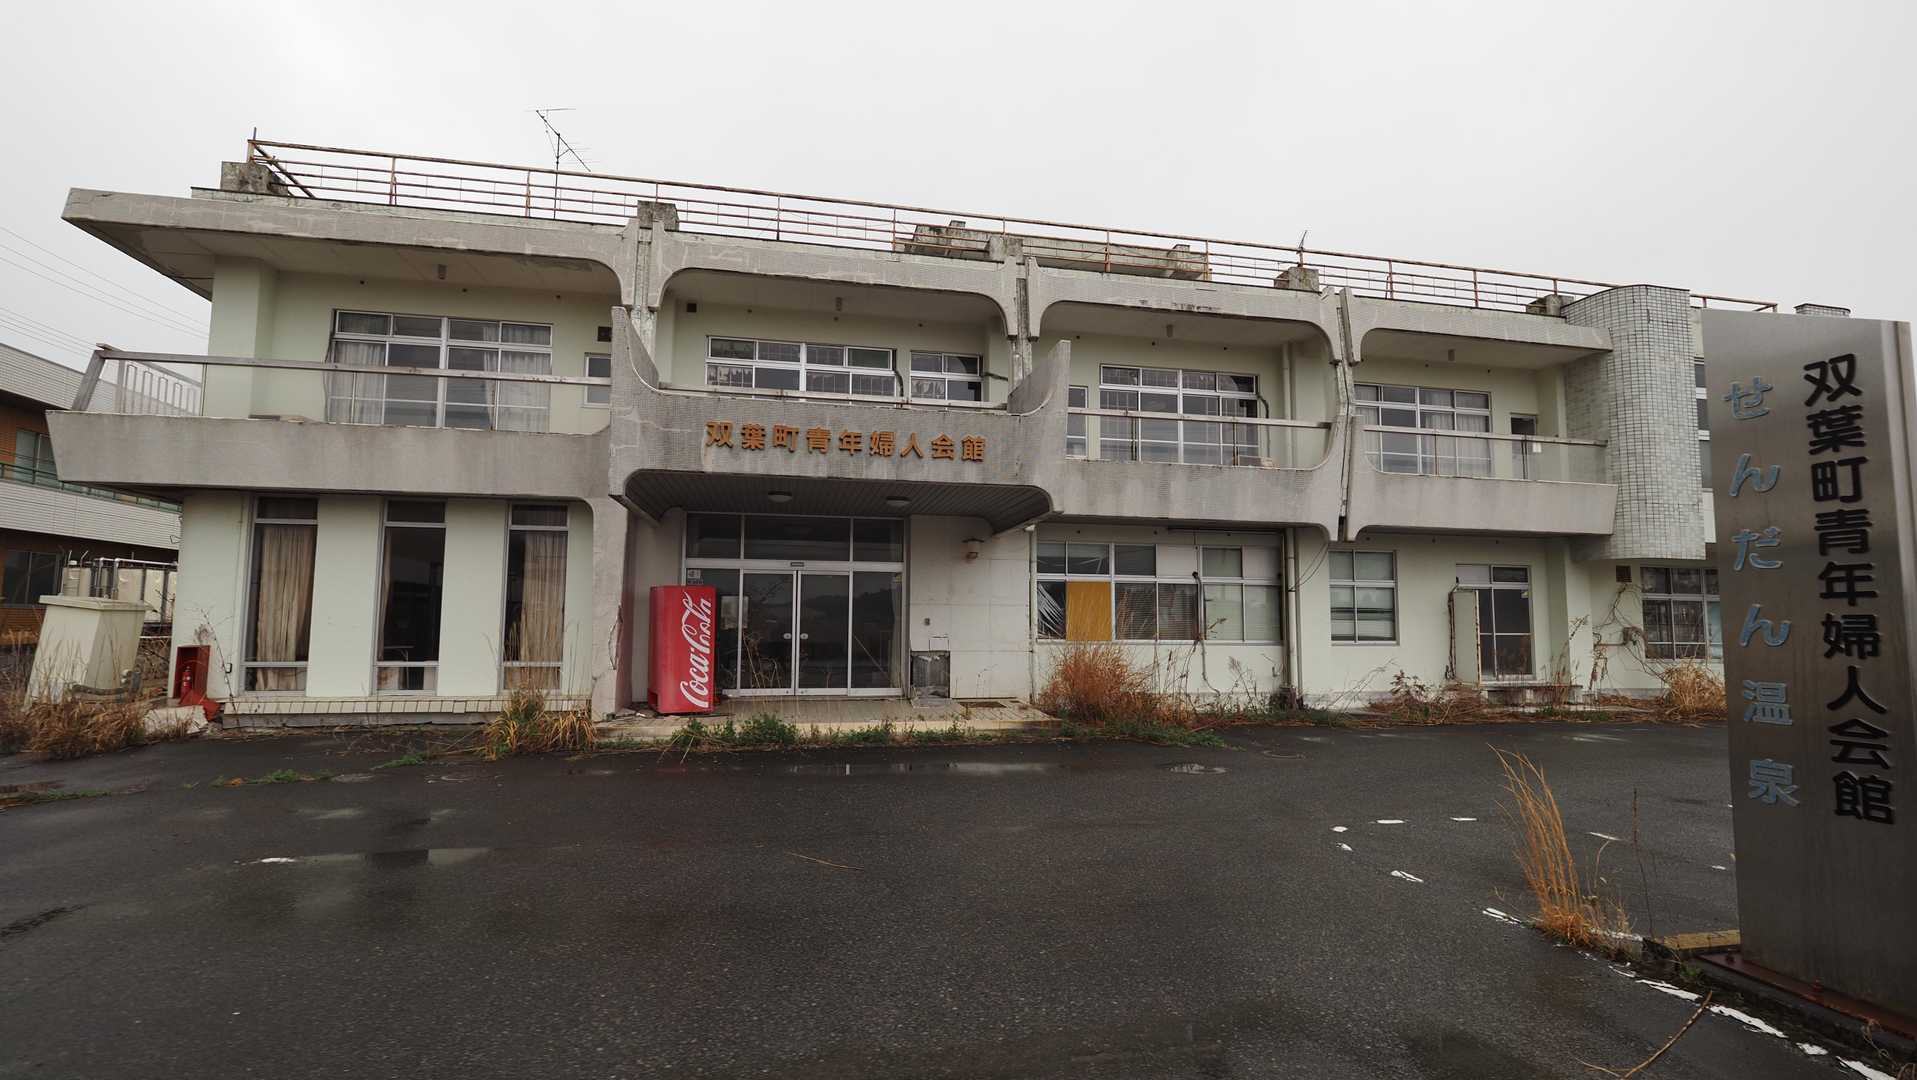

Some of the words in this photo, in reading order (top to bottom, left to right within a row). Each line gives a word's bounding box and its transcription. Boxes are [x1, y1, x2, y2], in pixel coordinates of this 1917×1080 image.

[705, 421, 987, 462] 双葉町青年婦人会館
[680, 591, 712, 708] Coca-Cola
[1724, 376, 1800, 807] せんだん温泉
[1803, 353, 1896, 825] 双葉町青年婦人会館
